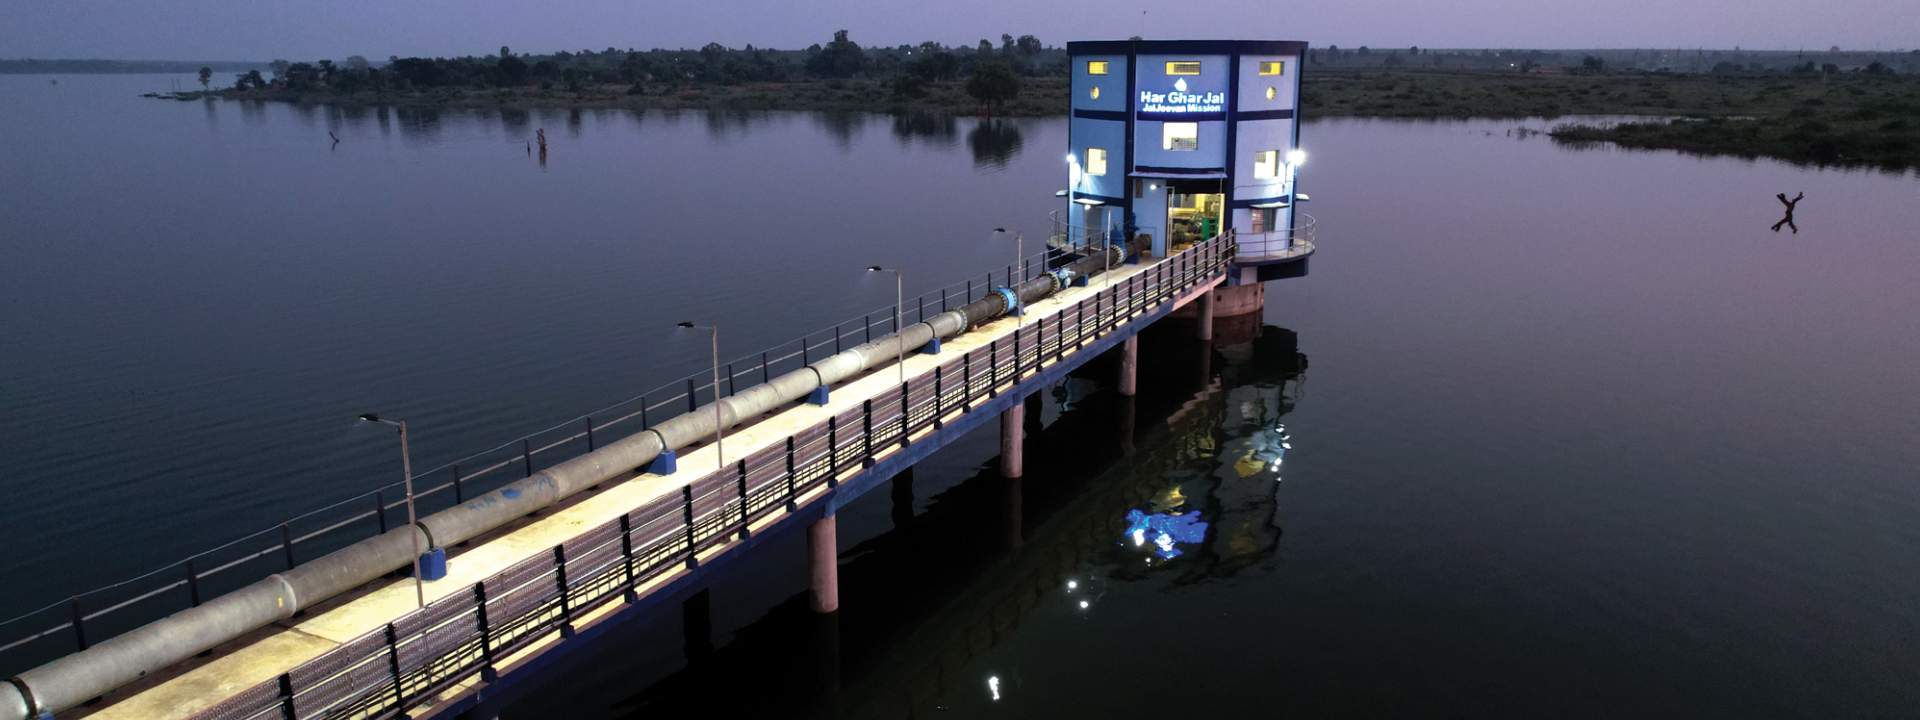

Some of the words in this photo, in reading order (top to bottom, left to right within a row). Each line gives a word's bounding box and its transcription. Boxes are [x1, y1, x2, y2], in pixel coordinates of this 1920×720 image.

[1141, 91, 1166, 103] Har
[1168, 91, 1202, 104] Ghar
[1202, 92, 1224, 104] Jal
[1187, 103, 1221, 112] Mission
